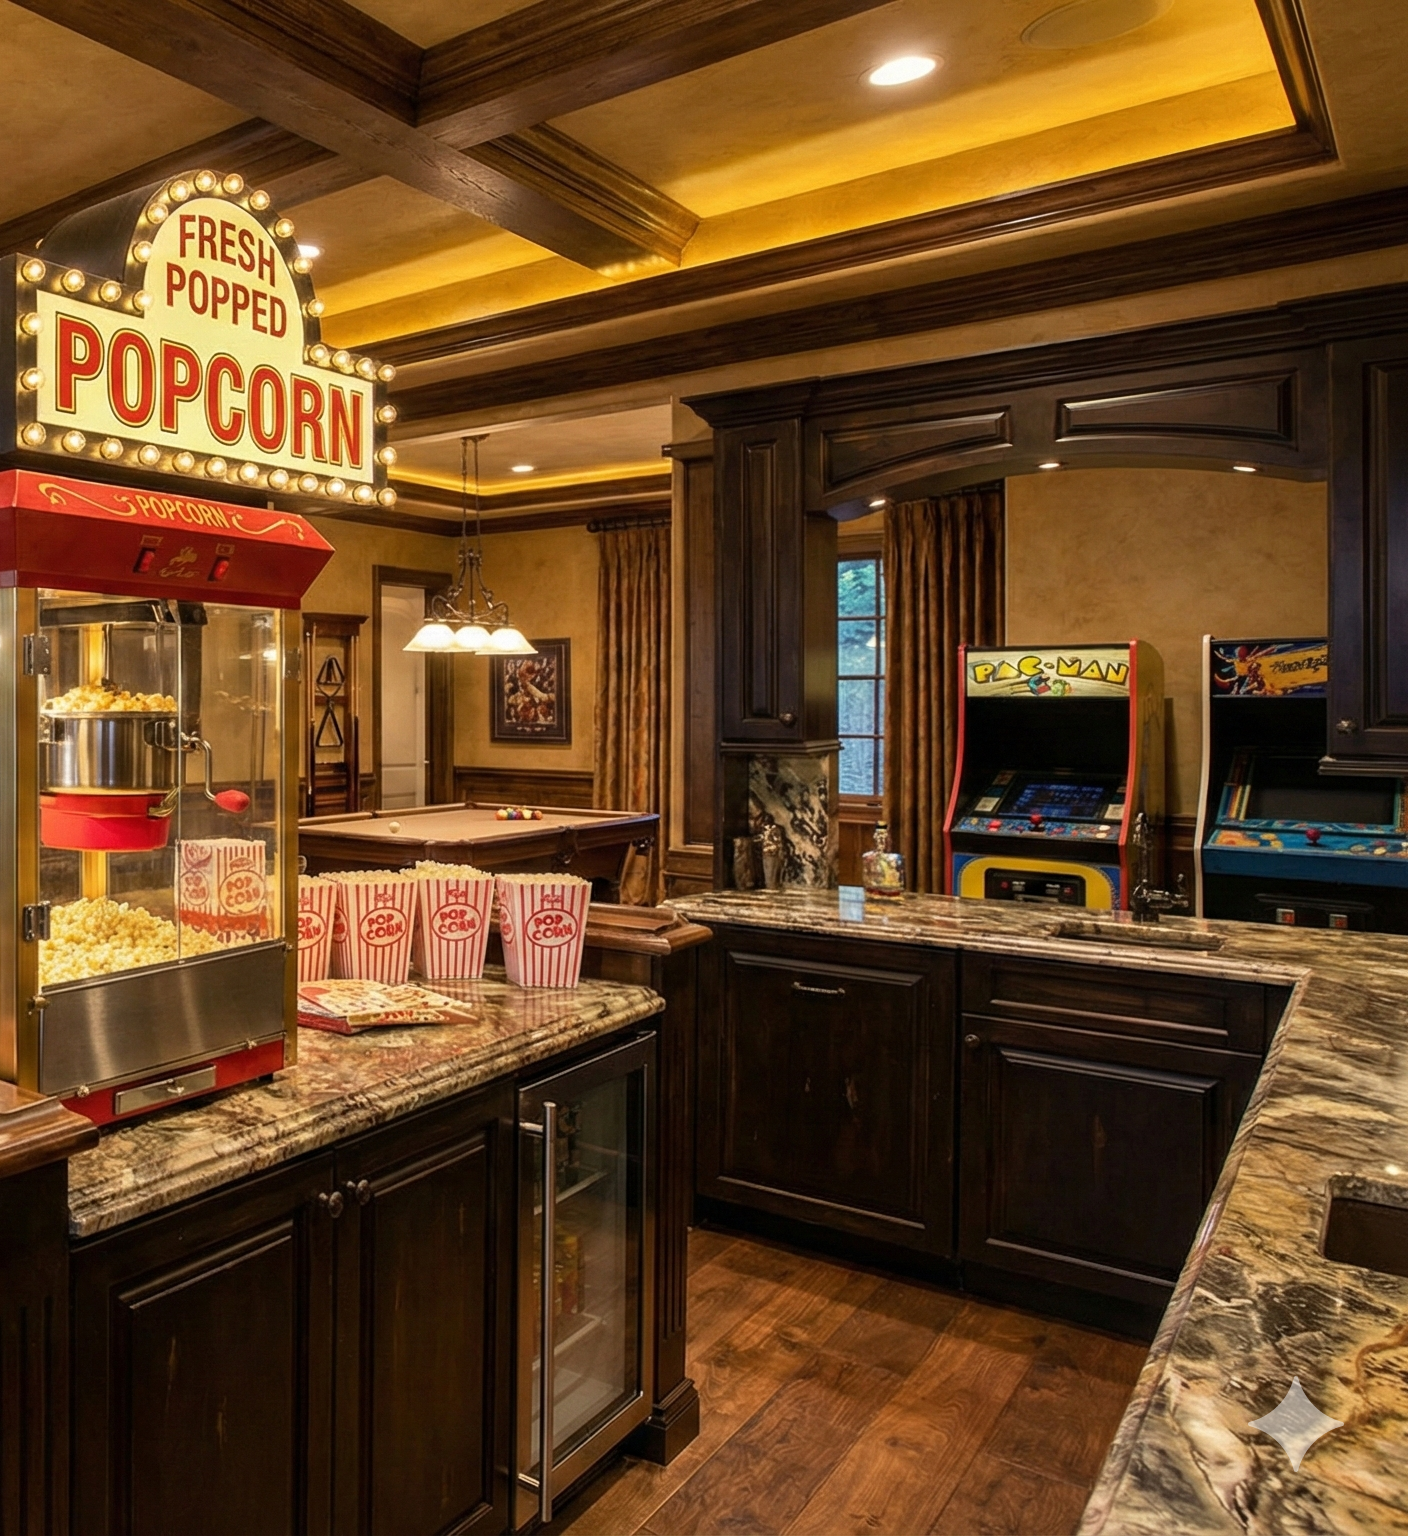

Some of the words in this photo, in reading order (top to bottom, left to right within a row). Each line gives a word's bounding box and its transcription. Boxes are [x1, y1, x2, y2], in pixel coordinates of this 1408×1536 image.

[179, 213, 276, 288] FRESH
[166, 261, 288, 339] POPPED
[55, 311, 364, 469] POPCORN
[135, 494, 230, 529] POPCORN
[297, 916, 313, 928] OP
[367, 912, 395, 928] POP
[439, 908, 468, 923] POP
[534, 914, 564, 929] POP
[297, 923, 322, 941] ORN
